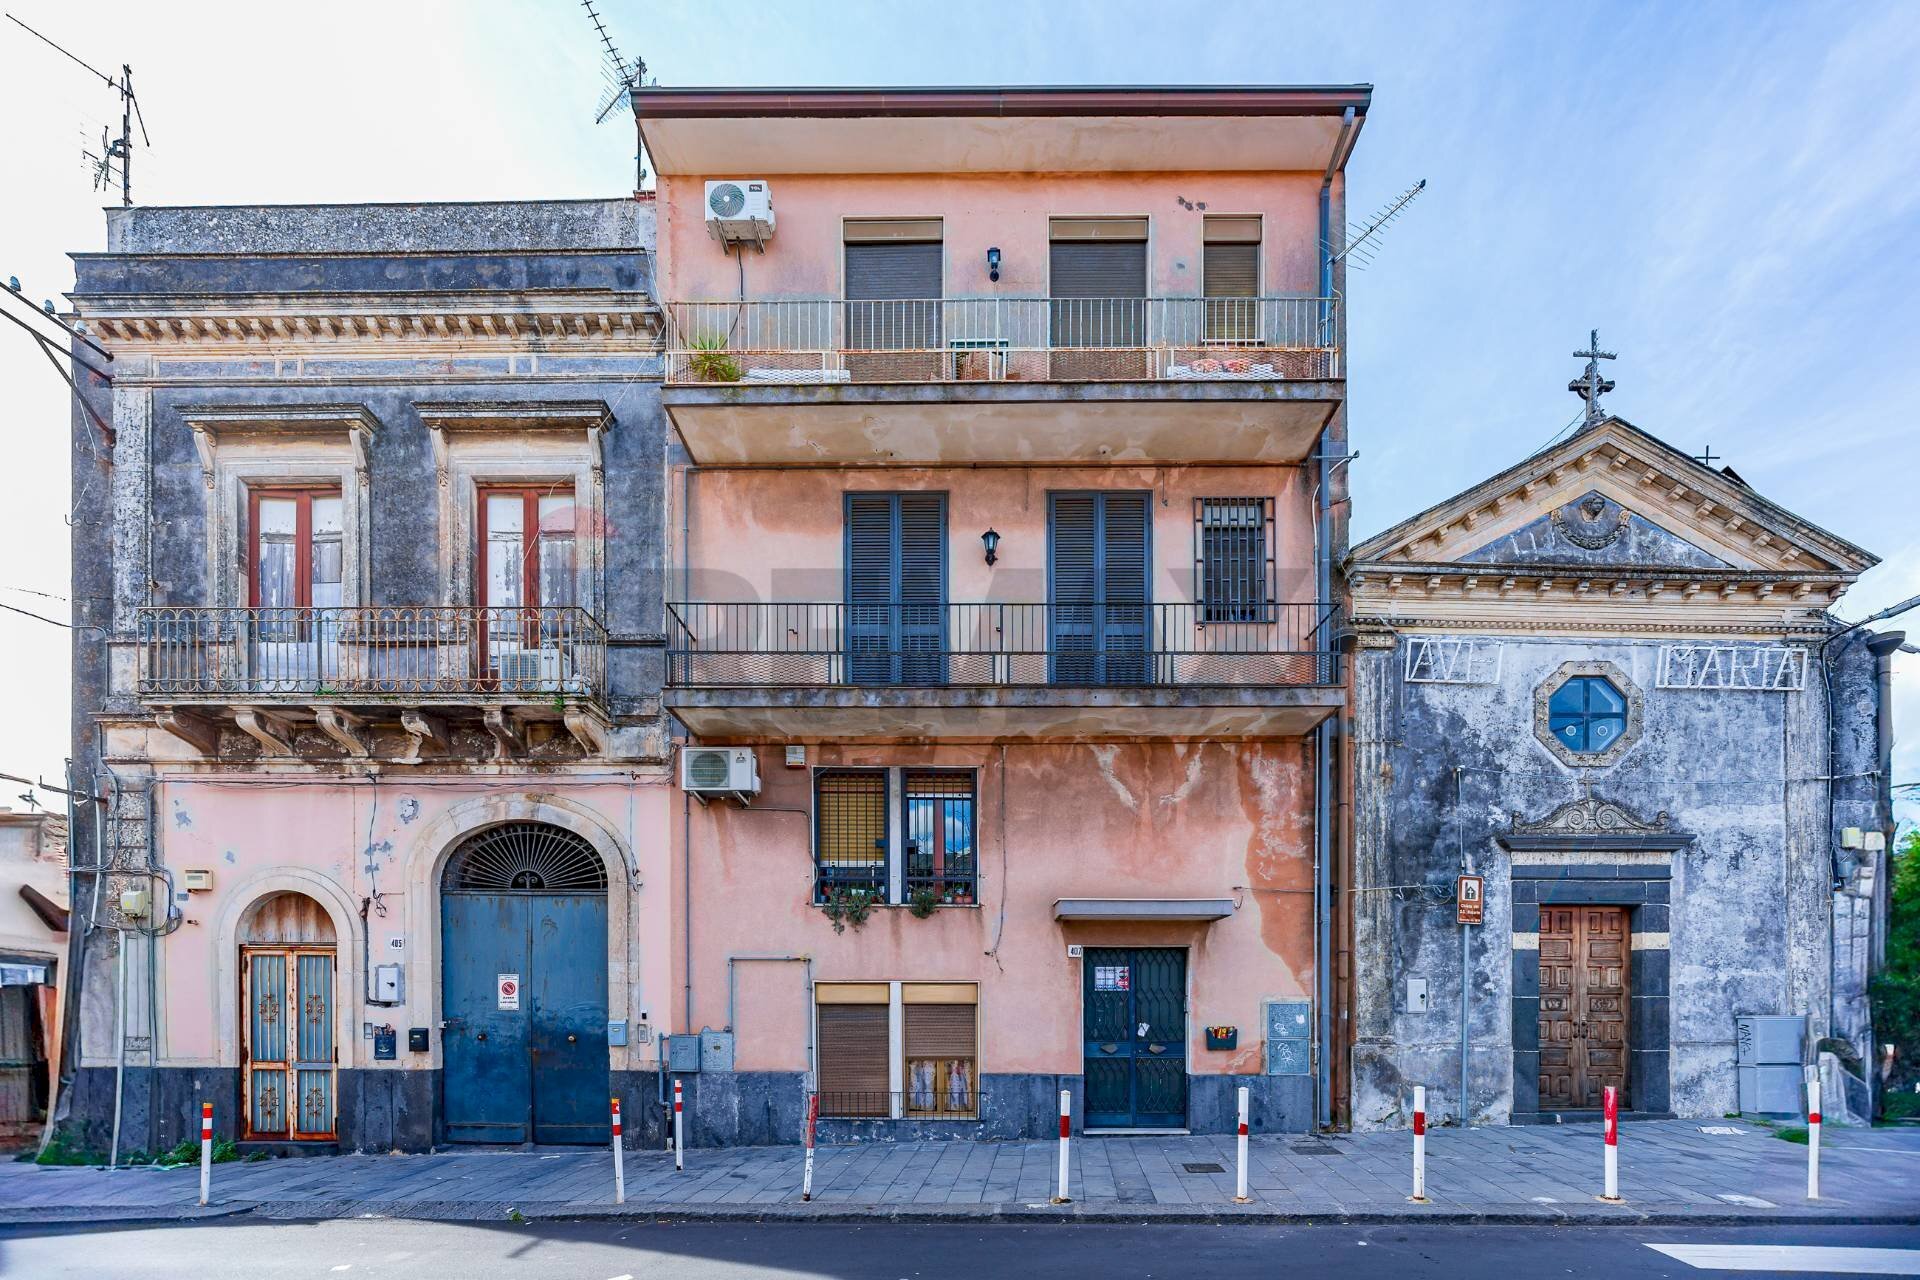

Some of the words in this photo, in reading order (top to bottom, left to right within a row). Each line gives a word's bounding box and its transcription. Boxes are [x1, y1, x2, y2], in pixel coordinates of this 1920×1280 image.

[1664, 646, 1801, 690] MARIA
[391, 939, 402, 947] 405
[1071, 947, 1082, 955] 407
